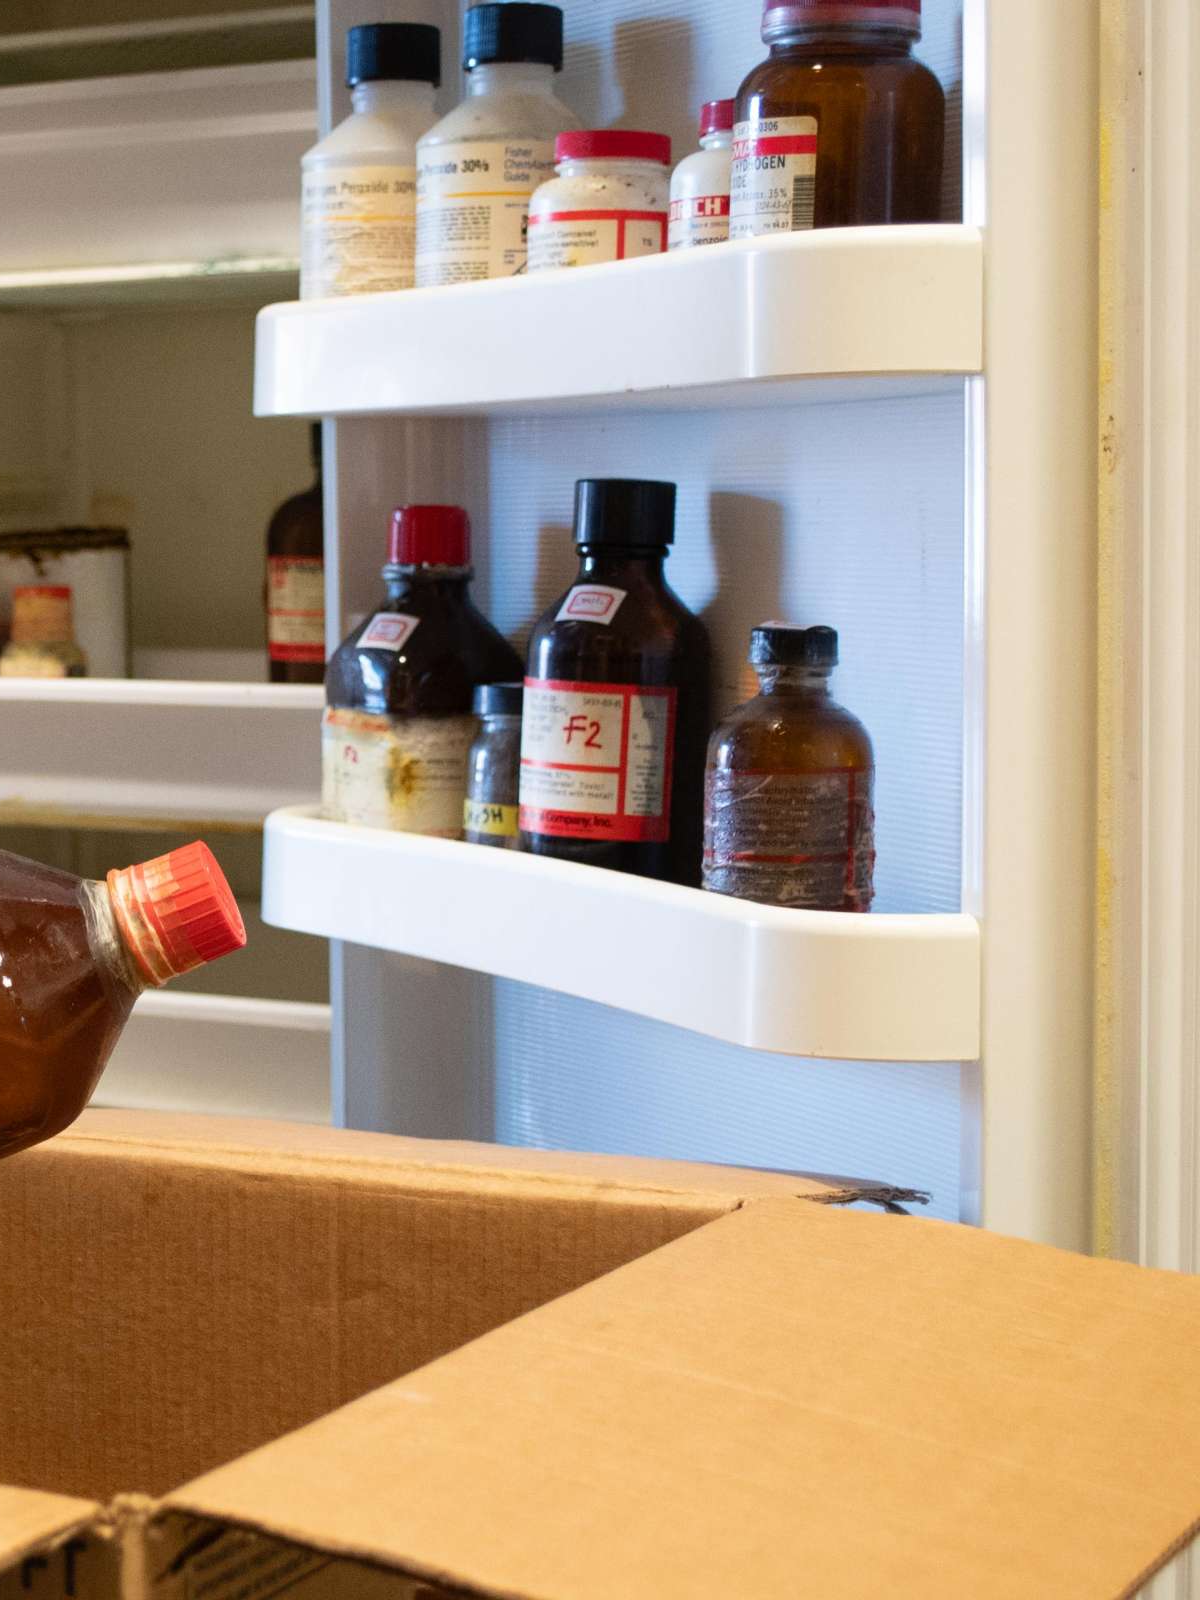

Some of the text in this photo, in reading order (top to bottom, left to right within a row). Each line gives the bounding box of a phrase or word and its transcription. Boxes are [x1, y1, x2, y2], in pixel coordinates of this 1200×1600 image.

[461, 159, 489, 173] 30%
[735, 155, 786, 173] HYDOGEN
[563, 714, 603, 750] F2
